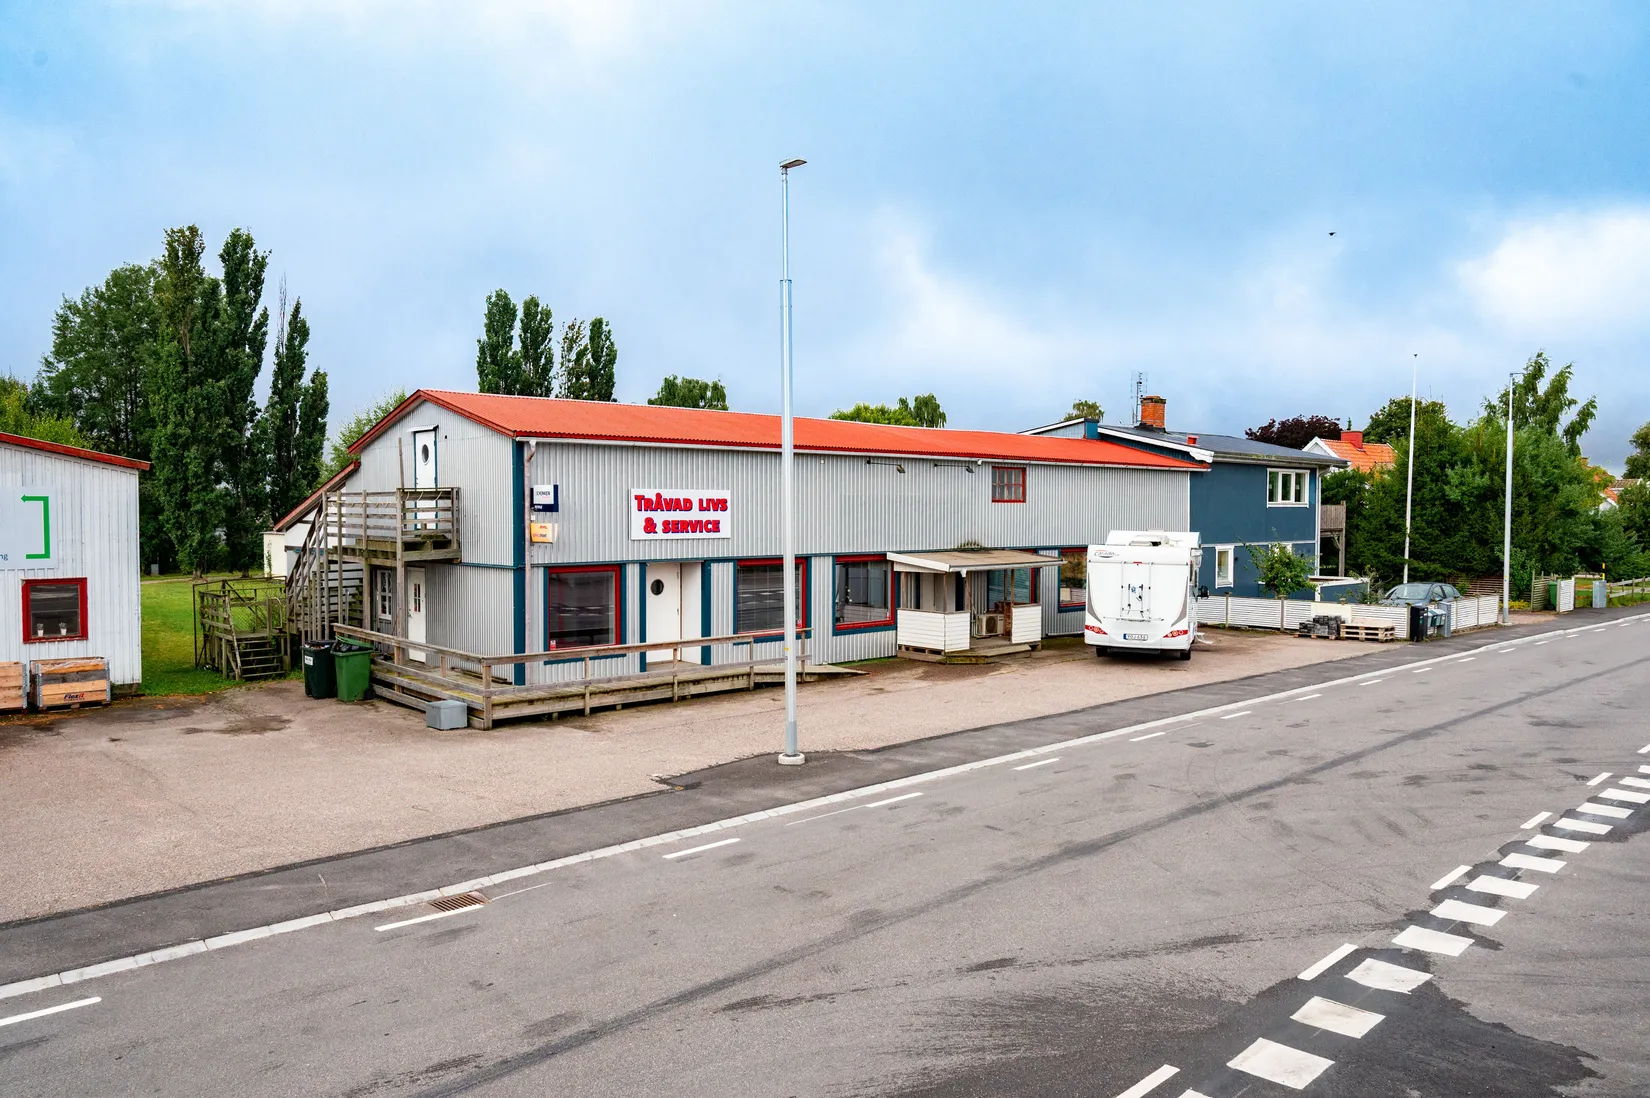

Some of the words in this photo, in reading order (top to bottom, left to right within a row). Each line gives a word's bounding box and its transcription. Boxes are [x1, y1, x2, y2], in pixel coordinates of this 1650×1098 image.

[634, 492, 693, 512] TRÅVAD
[698, 498, 728, 512] LIVS
[643, 516, 658, 534] &
[661, 519, 721, 534] SERVICE
